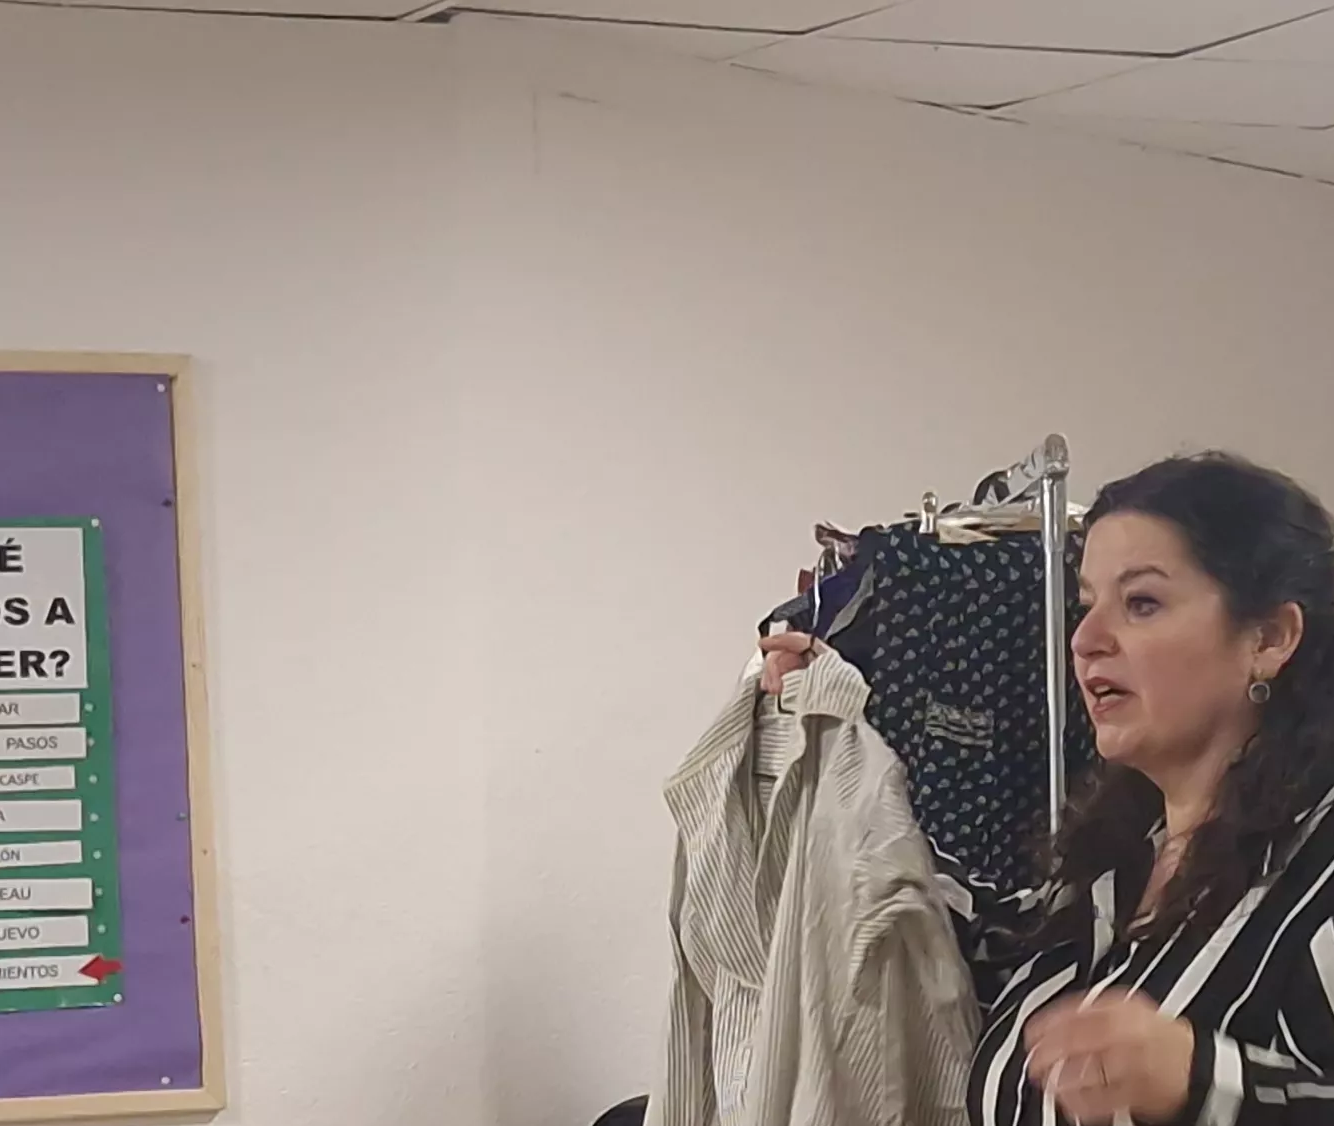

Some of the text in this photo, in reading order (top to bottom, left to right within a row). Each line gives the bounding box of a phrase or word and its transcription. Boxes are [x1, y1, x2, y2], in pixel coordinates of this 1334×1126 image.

[44, 597, 75, 625] A
[6, 736, 58, 749] PASOS
[0, 773, 40, 787] CASPE
